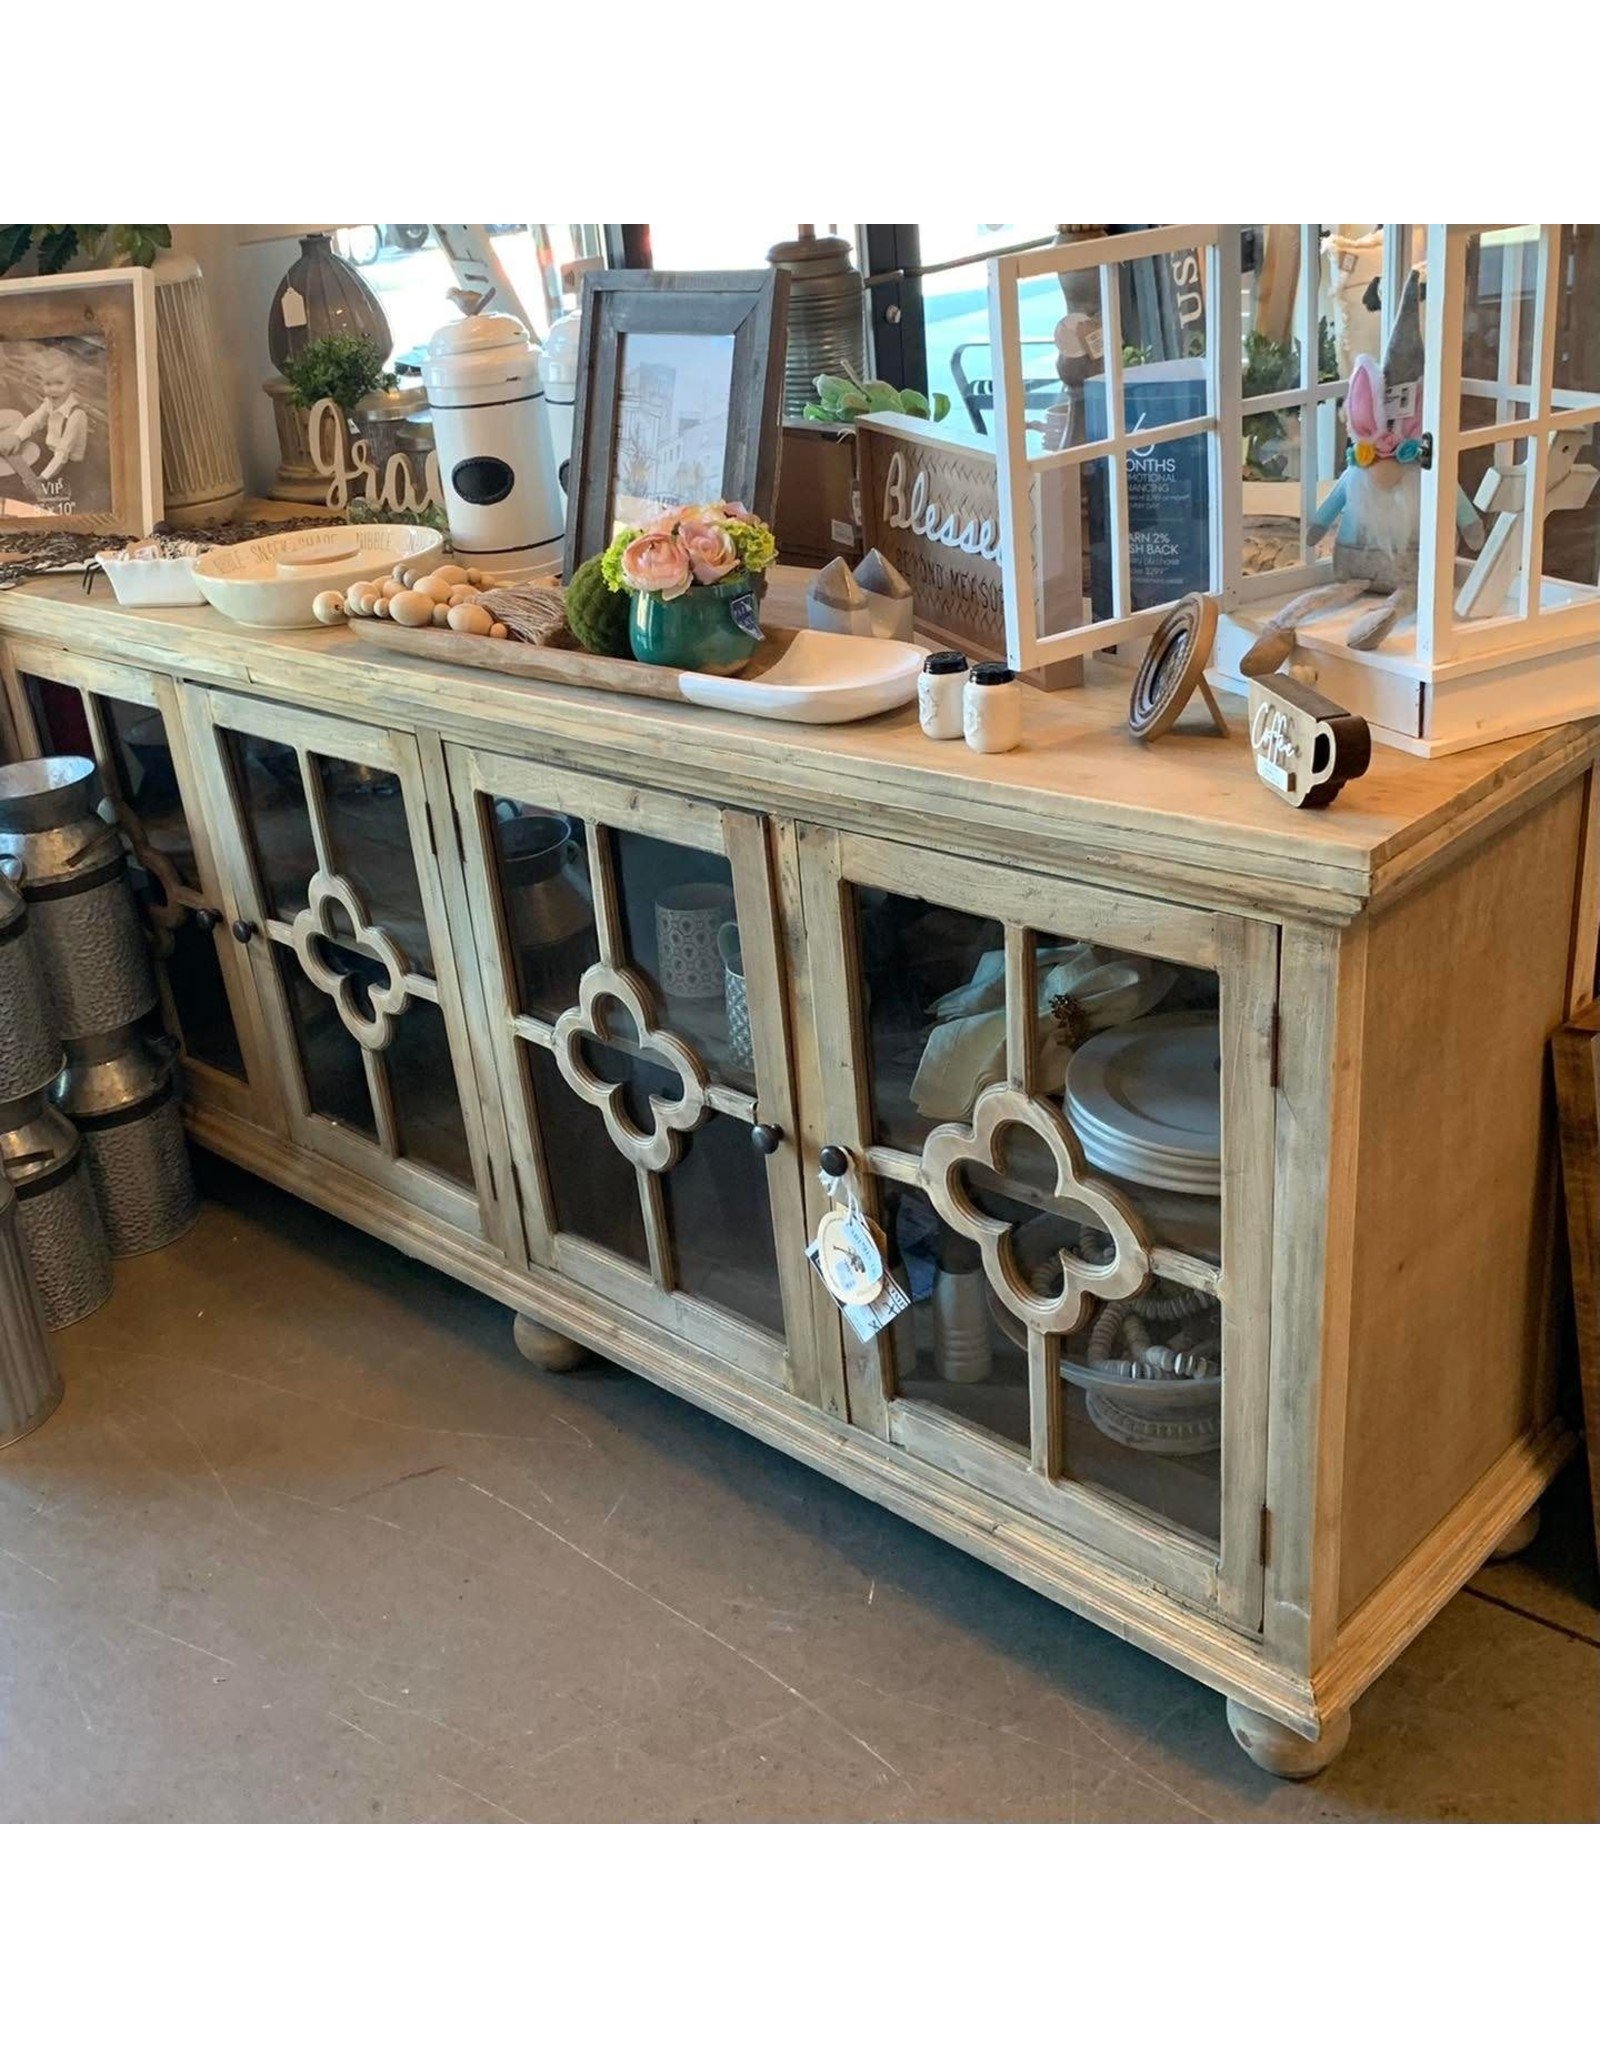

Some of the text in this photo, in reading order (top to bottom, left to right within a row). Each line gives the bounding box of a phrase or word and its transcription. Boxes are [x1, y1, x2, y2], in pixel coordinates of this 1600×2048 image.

[1171, 248, 1203, 329] US
[1126, 458, 1177, 473] ONTHS
[883, 451, 1003, 568] Blesse
[1129, 532, 1171, 543] ARN 2%
[1129, 543, 1180, 555] SH BACK
[1251, 702, 1295, 765] Coffee
